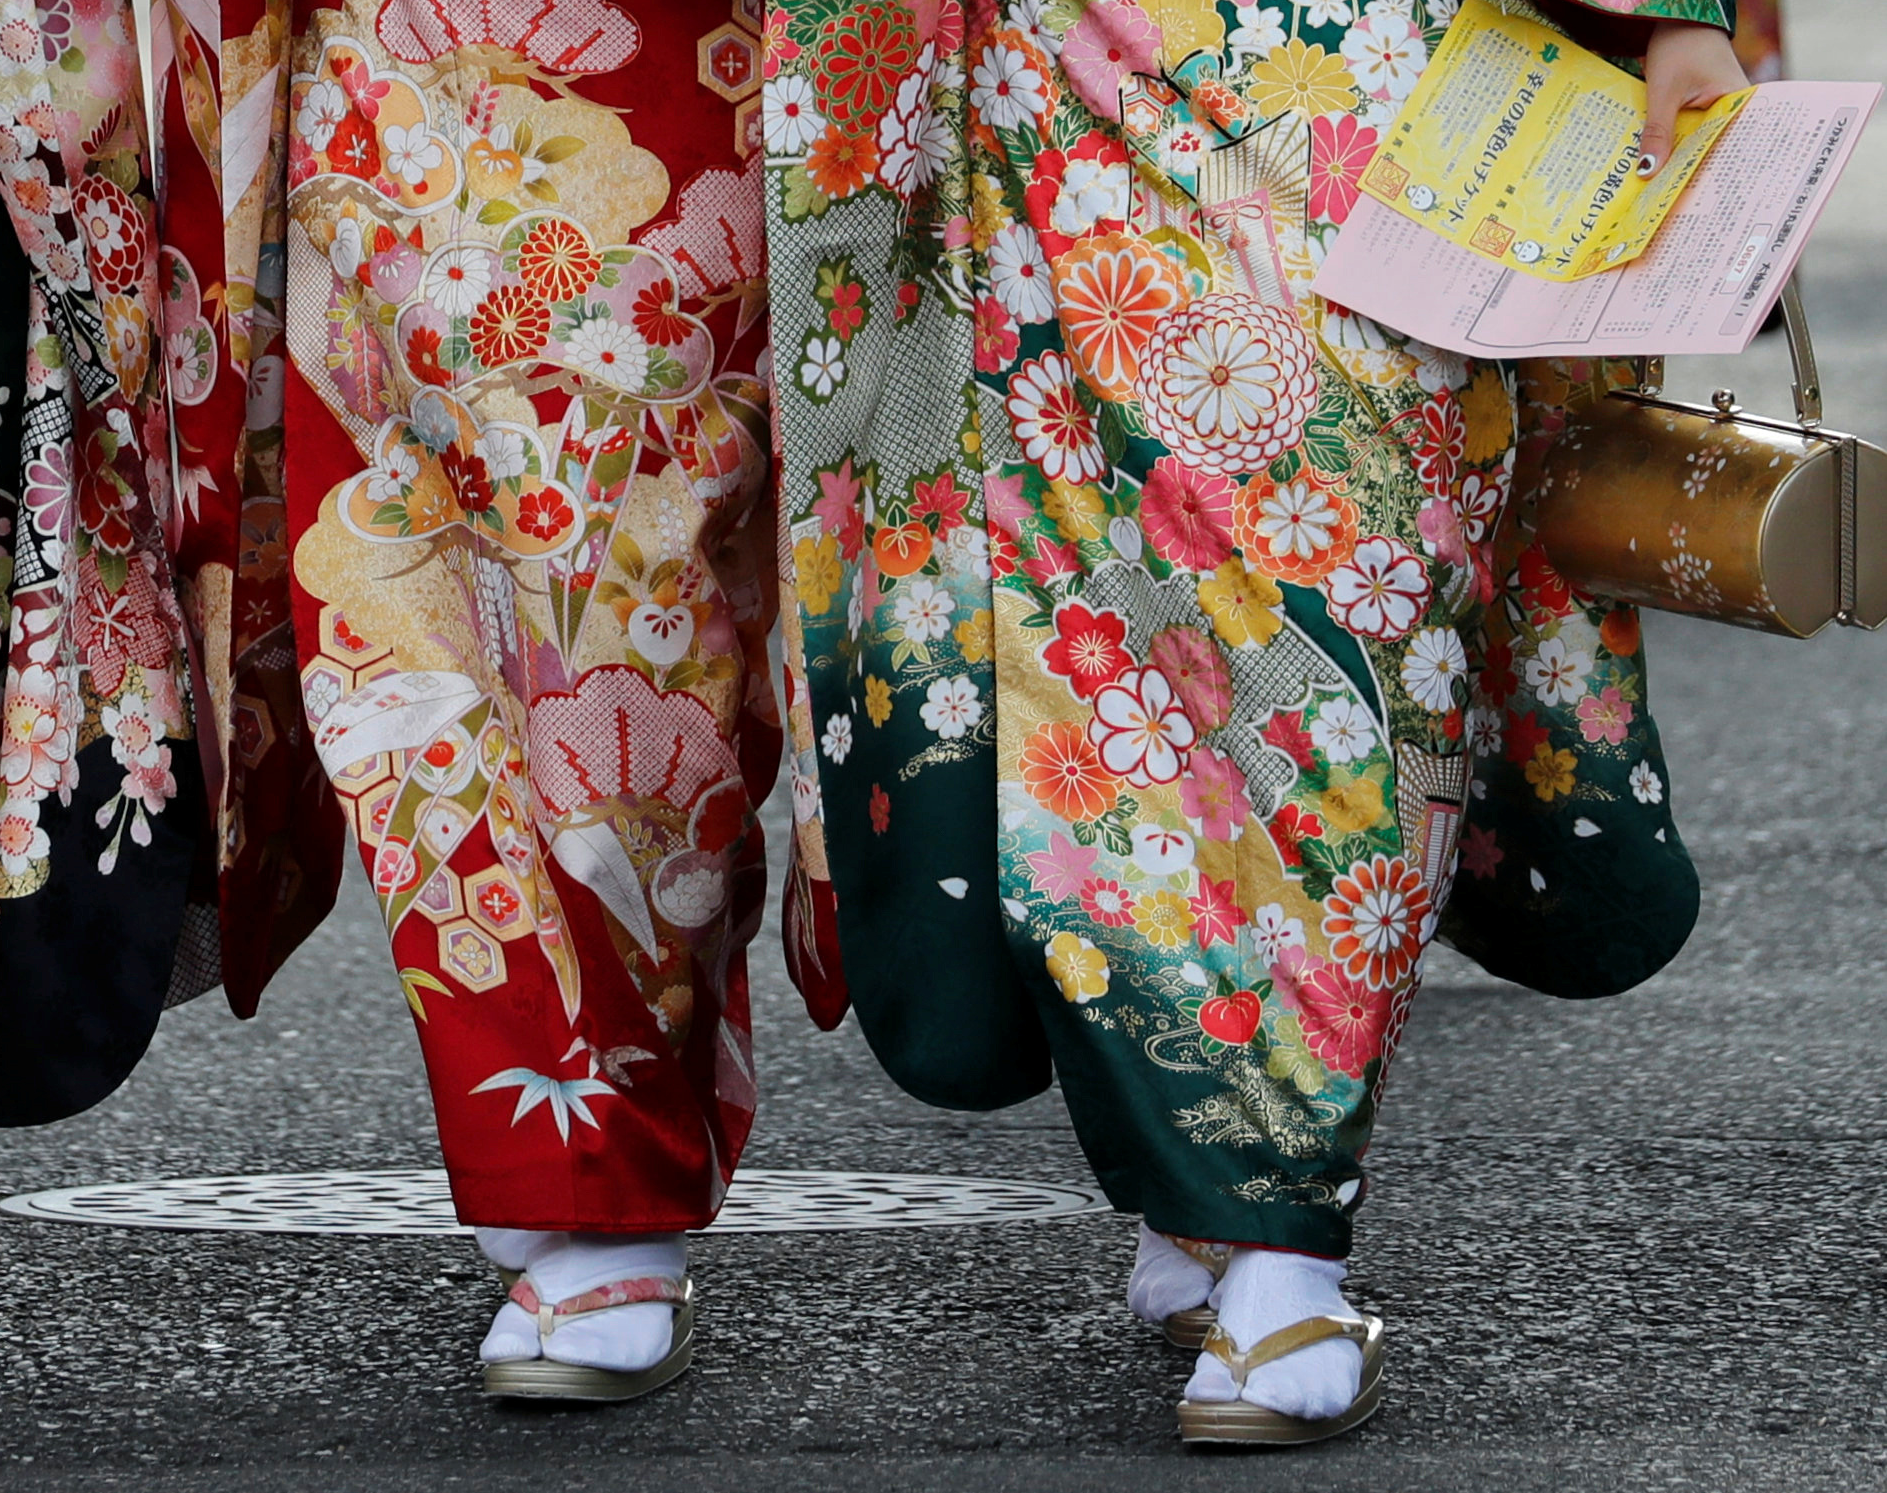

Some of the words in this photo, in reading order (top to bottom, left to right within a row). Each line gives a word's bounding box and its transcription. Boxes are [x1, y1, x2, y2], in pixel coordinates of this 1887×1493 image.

[1439, 60, 1551, 235] 『幸せの黄色いチケット』
[1547, 125, 1645, 277] 幸せの黄色いチケット』
[1733, 243, 1758, 275] 0687
